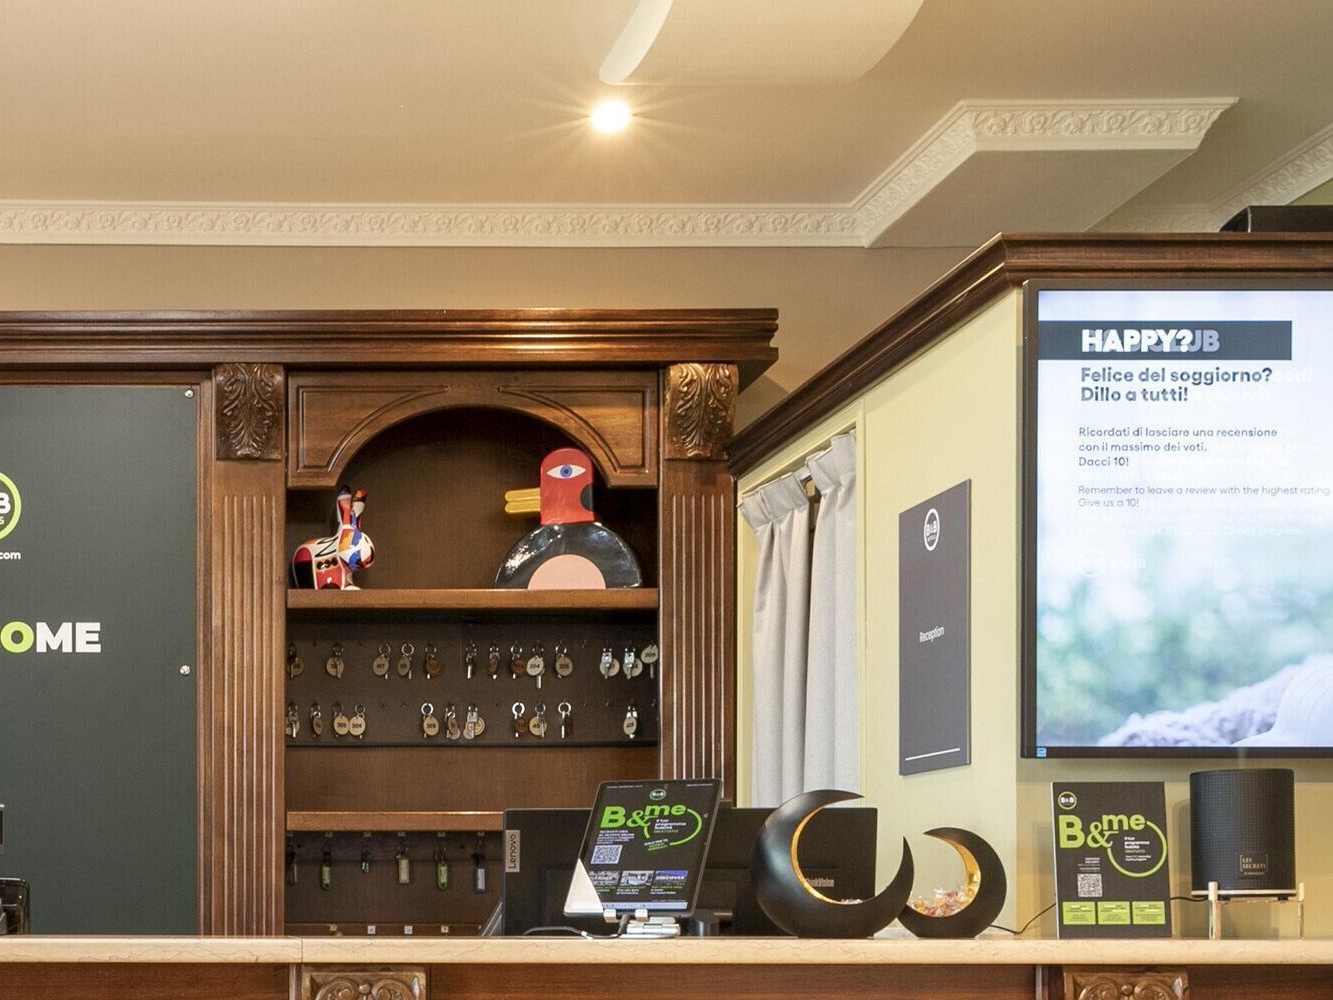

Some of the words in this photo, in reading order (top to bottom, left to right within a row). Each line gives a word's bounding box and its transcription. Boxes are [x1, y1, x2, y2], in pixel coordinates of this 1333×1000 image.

[1081, 329, 1193, 353] HAPPY?
[1081, 367, 1133, 382] Felice
[1138, 367, 1166, 382] del
[1170, 367, 1272, 386] soggiorno?
[1081, 387, 1120, 402] Dillo
[1125, 390, 1137, 402] a
[1141, 387, 1188, 402] tutti!
[1078, 426, 1130, 437] Ricordati
[1132, 426, 1143, 437] di
[1145, 426, 1190, 437] lasciare
[1192, 429, 1214, 437] una
[1216, 426, 1278, 437] recensione
[1078, 444, 1099, 452] con
[1102, 442, 1108, 452] il
[1110, 442, 1161, 452] massimo
[1163, 442, 1181, 452] dei
[1183, 442, 1207, 452] voti.
[1078, 456, 1111, 467] Dacci
[1113, 456, 1129, 467] 10!
[1078, 485, 1132, 495] Remember
[1135, 486, 1145, 495] to
[1147, 485, 1174, 495] leave
[1176, 487, 1183, 495] a
[1185, 486, 1217, 495] review
[1219, 486, 1241, 495] with
[1243, 486, 1259, 495] the
[1261, 485, 1298, 497] highest
[1300, 486, 1331, 497] rating
[1078, 498, 1101, 507] Give
[1103, 499, 1115, 507] us
[1126, 498, 1139, 507] 10!
[919, 626, 945, 643] Reception
[600, 804, 687, 828] B&me
[1058, 814, 1146, 848] B&me
[508, 833, 517, 869] Lenovo
